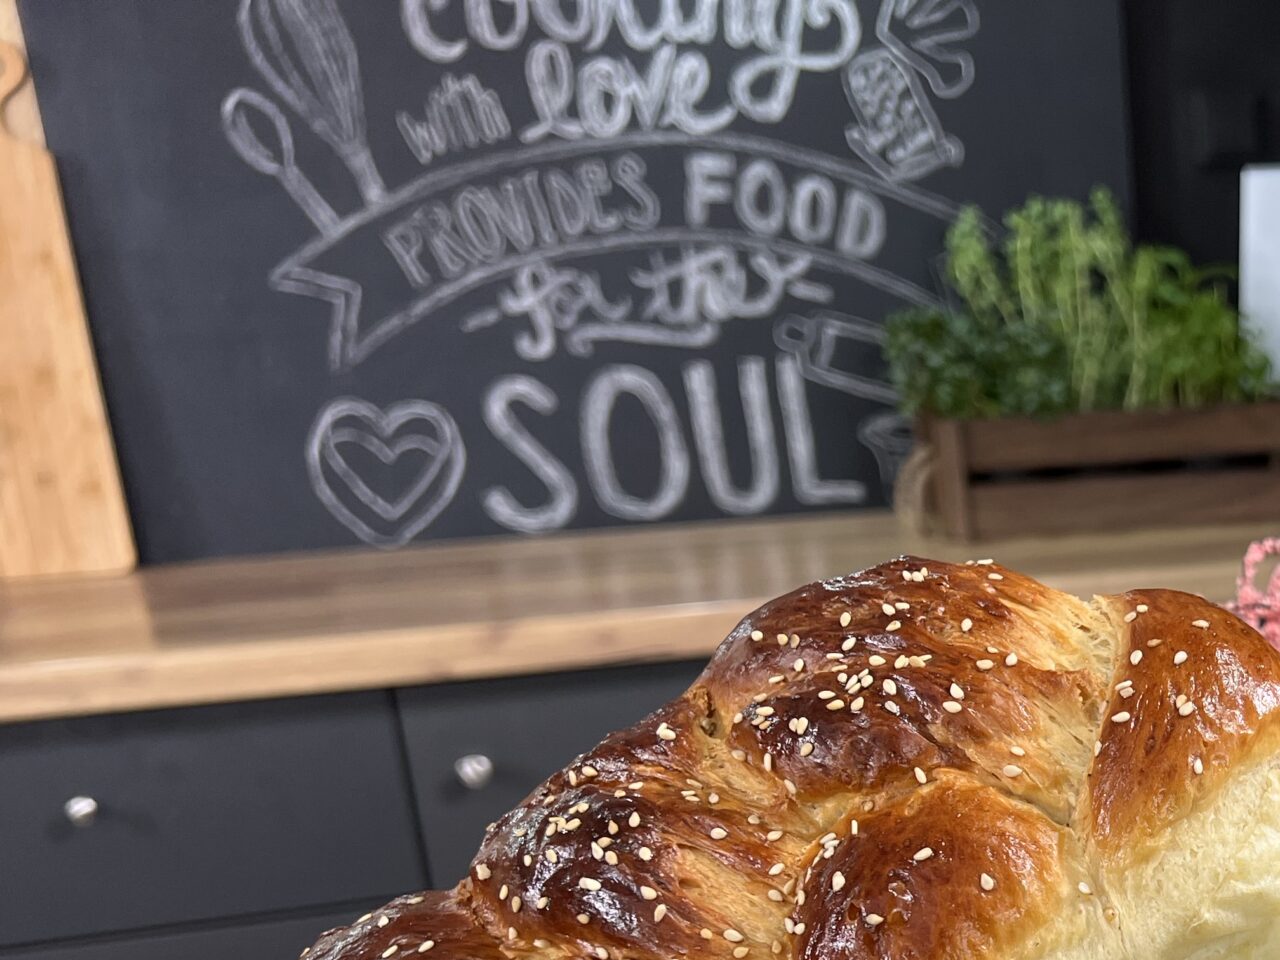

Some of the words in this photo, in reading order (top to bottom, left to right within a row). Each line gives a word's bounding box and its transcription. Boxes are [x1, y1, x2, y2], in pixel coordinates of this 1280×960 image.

[519, 38, 738, 143] love
[382, 151, 661, 289] PROVIDES
[684, 152, 887, 260] FOOD
[483, 355, 866, 534] SOUL
